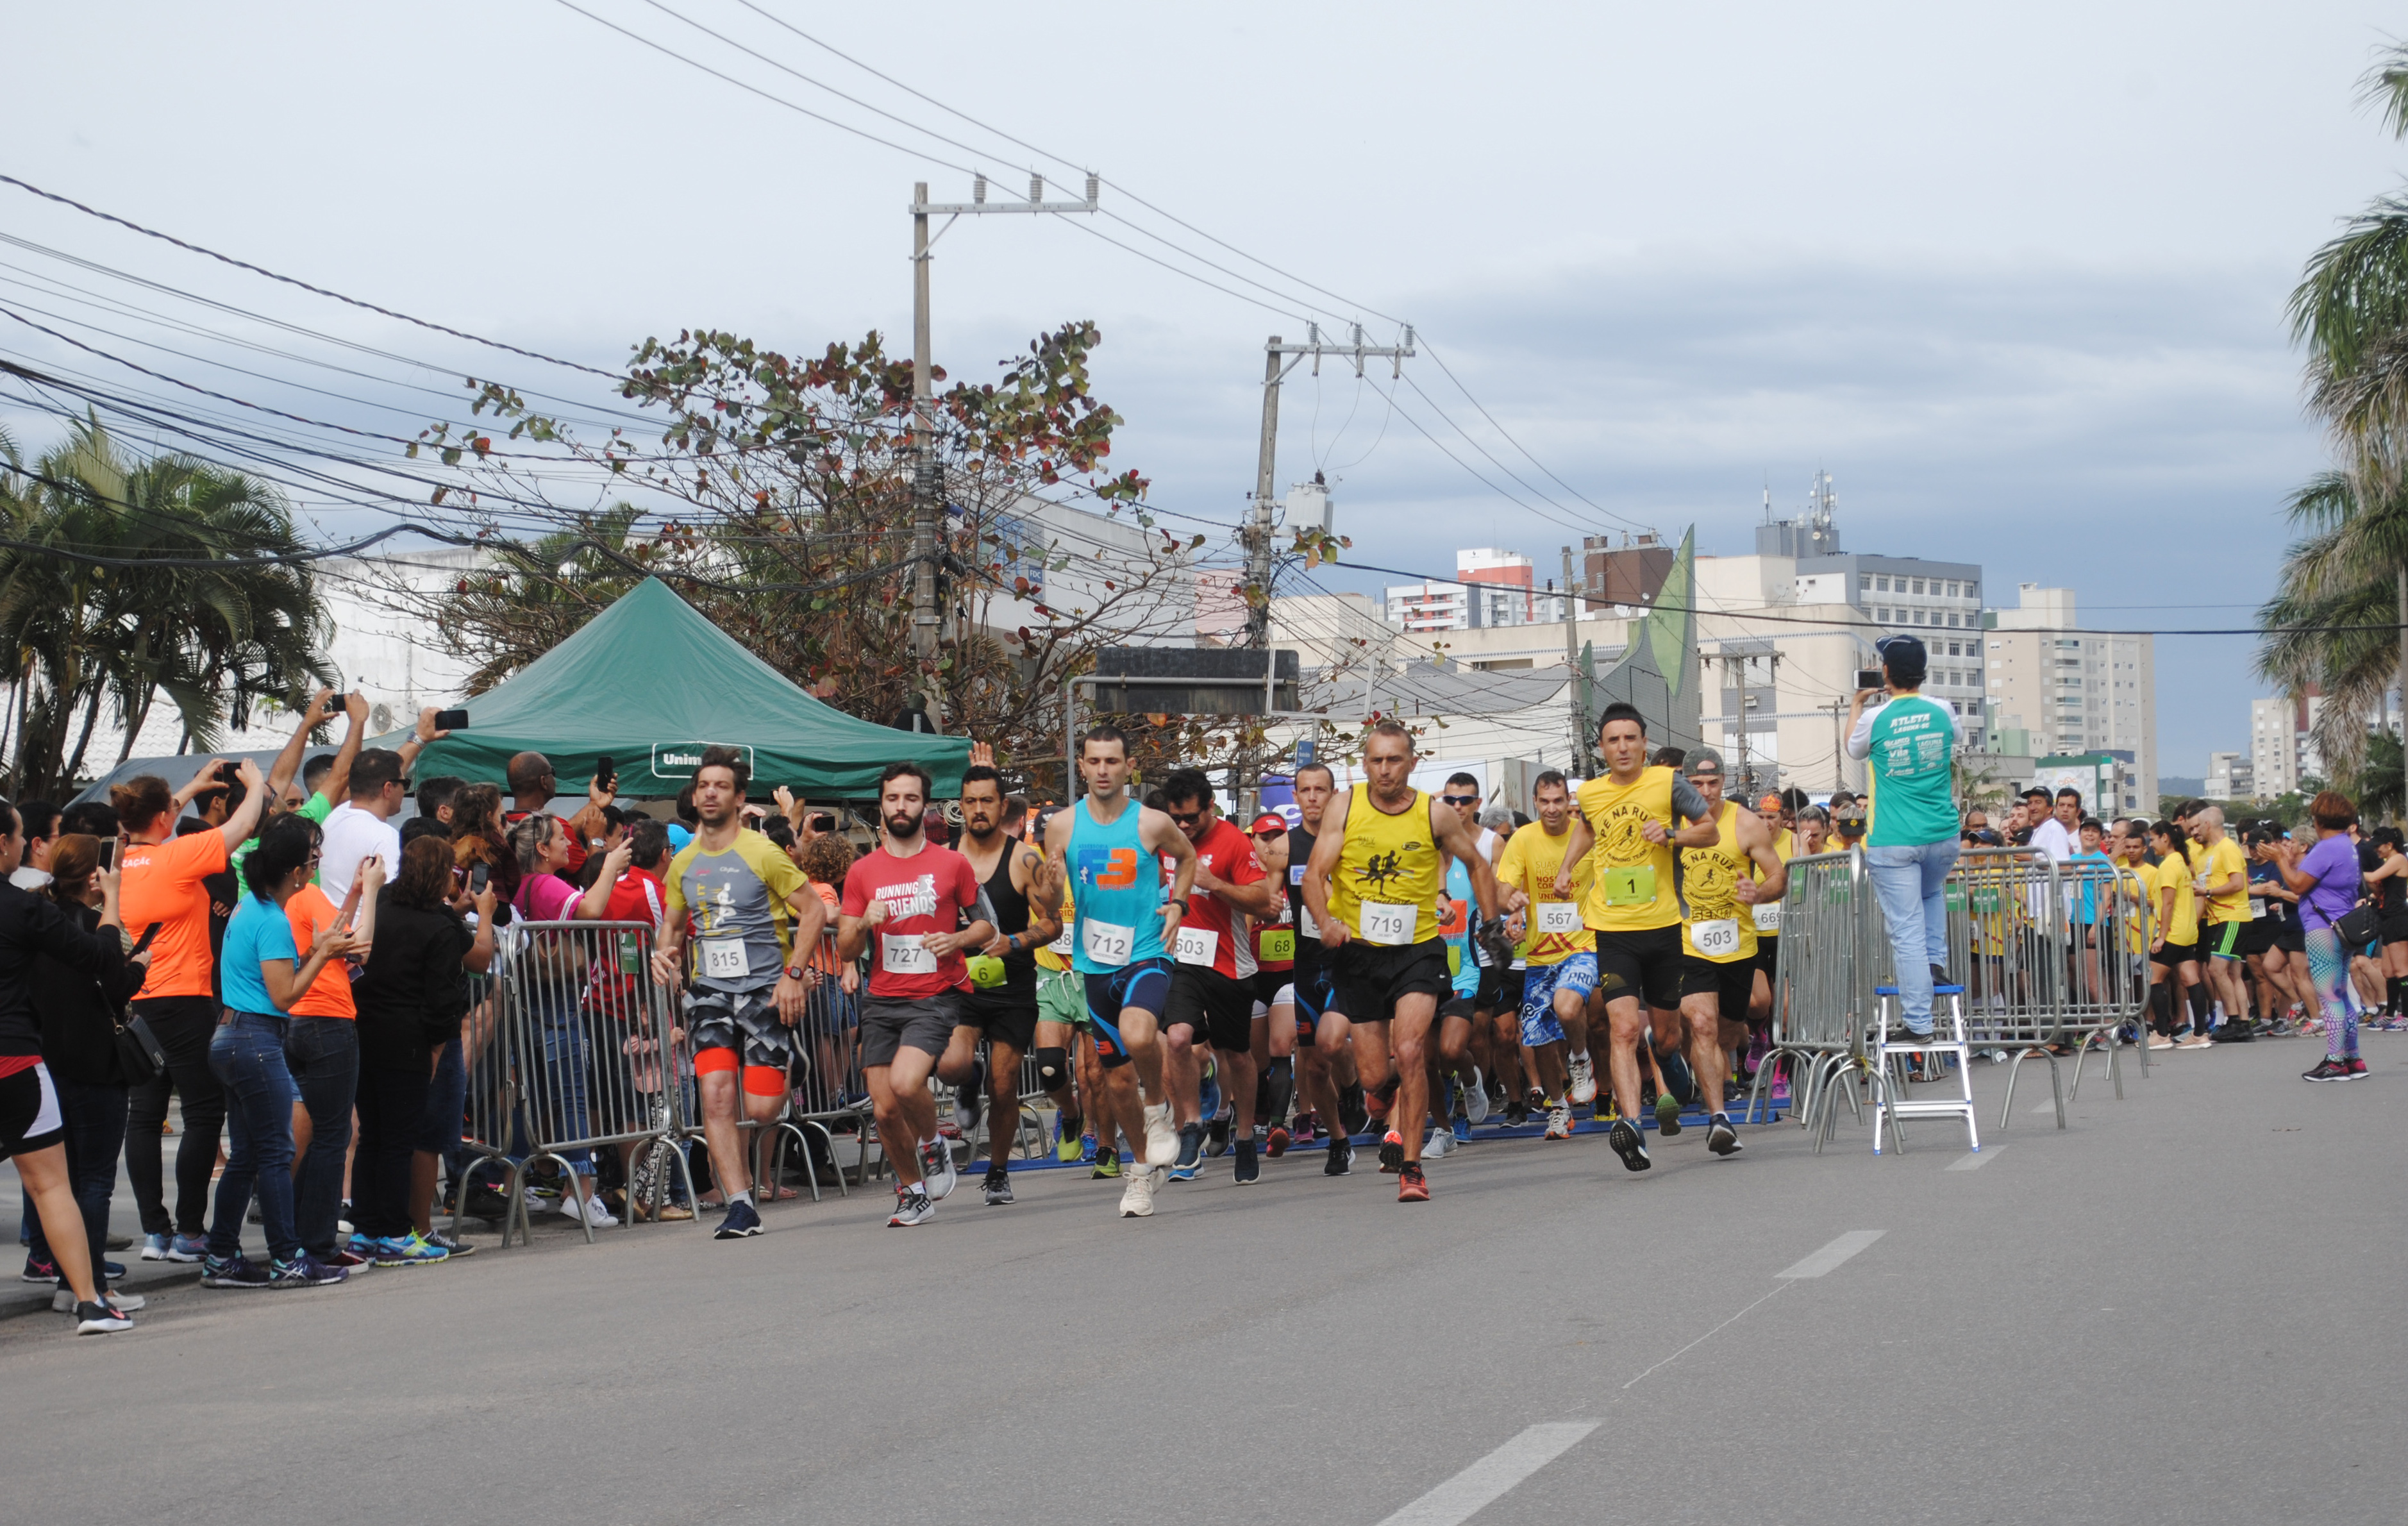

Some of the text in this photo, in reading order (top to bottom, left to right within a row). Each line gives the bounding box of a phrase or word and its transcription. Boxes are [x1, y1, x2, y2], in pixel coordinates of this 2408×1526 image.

[1030, 569, 1041, 579] FDC
[1890, 713, 1930, 728] ATLETA
[664, 753, 702, 766] Unim
[1612, 806, 1628, 820] NA
[1632, 807, 1648, 822] RU
[1633, 848, 1648, 860] TEAM
[1690, 851, 1707, 864] NA
[1711, 853, 1735, 872] RUA
[697, 883, 706, 896] IT
[875, 881, 919, 901] RUNNING
[1627, 878, 1635, 894] 1
[698, 900, 711, 930] MOVE
[1547, 912, 1572, 925] 567
[1371, 916, 1402, 934] 719
[1092, 934, 1125, 955] 712
[1703, 930, 1732, 947] 503
[1176, 938, 1204, 955] 603
[1275, 940, 1290, 953] 68
[712, 952, 739, 967] 815
[890, 948, 921, 962] 727
[978, 967, 988, 980] 6
